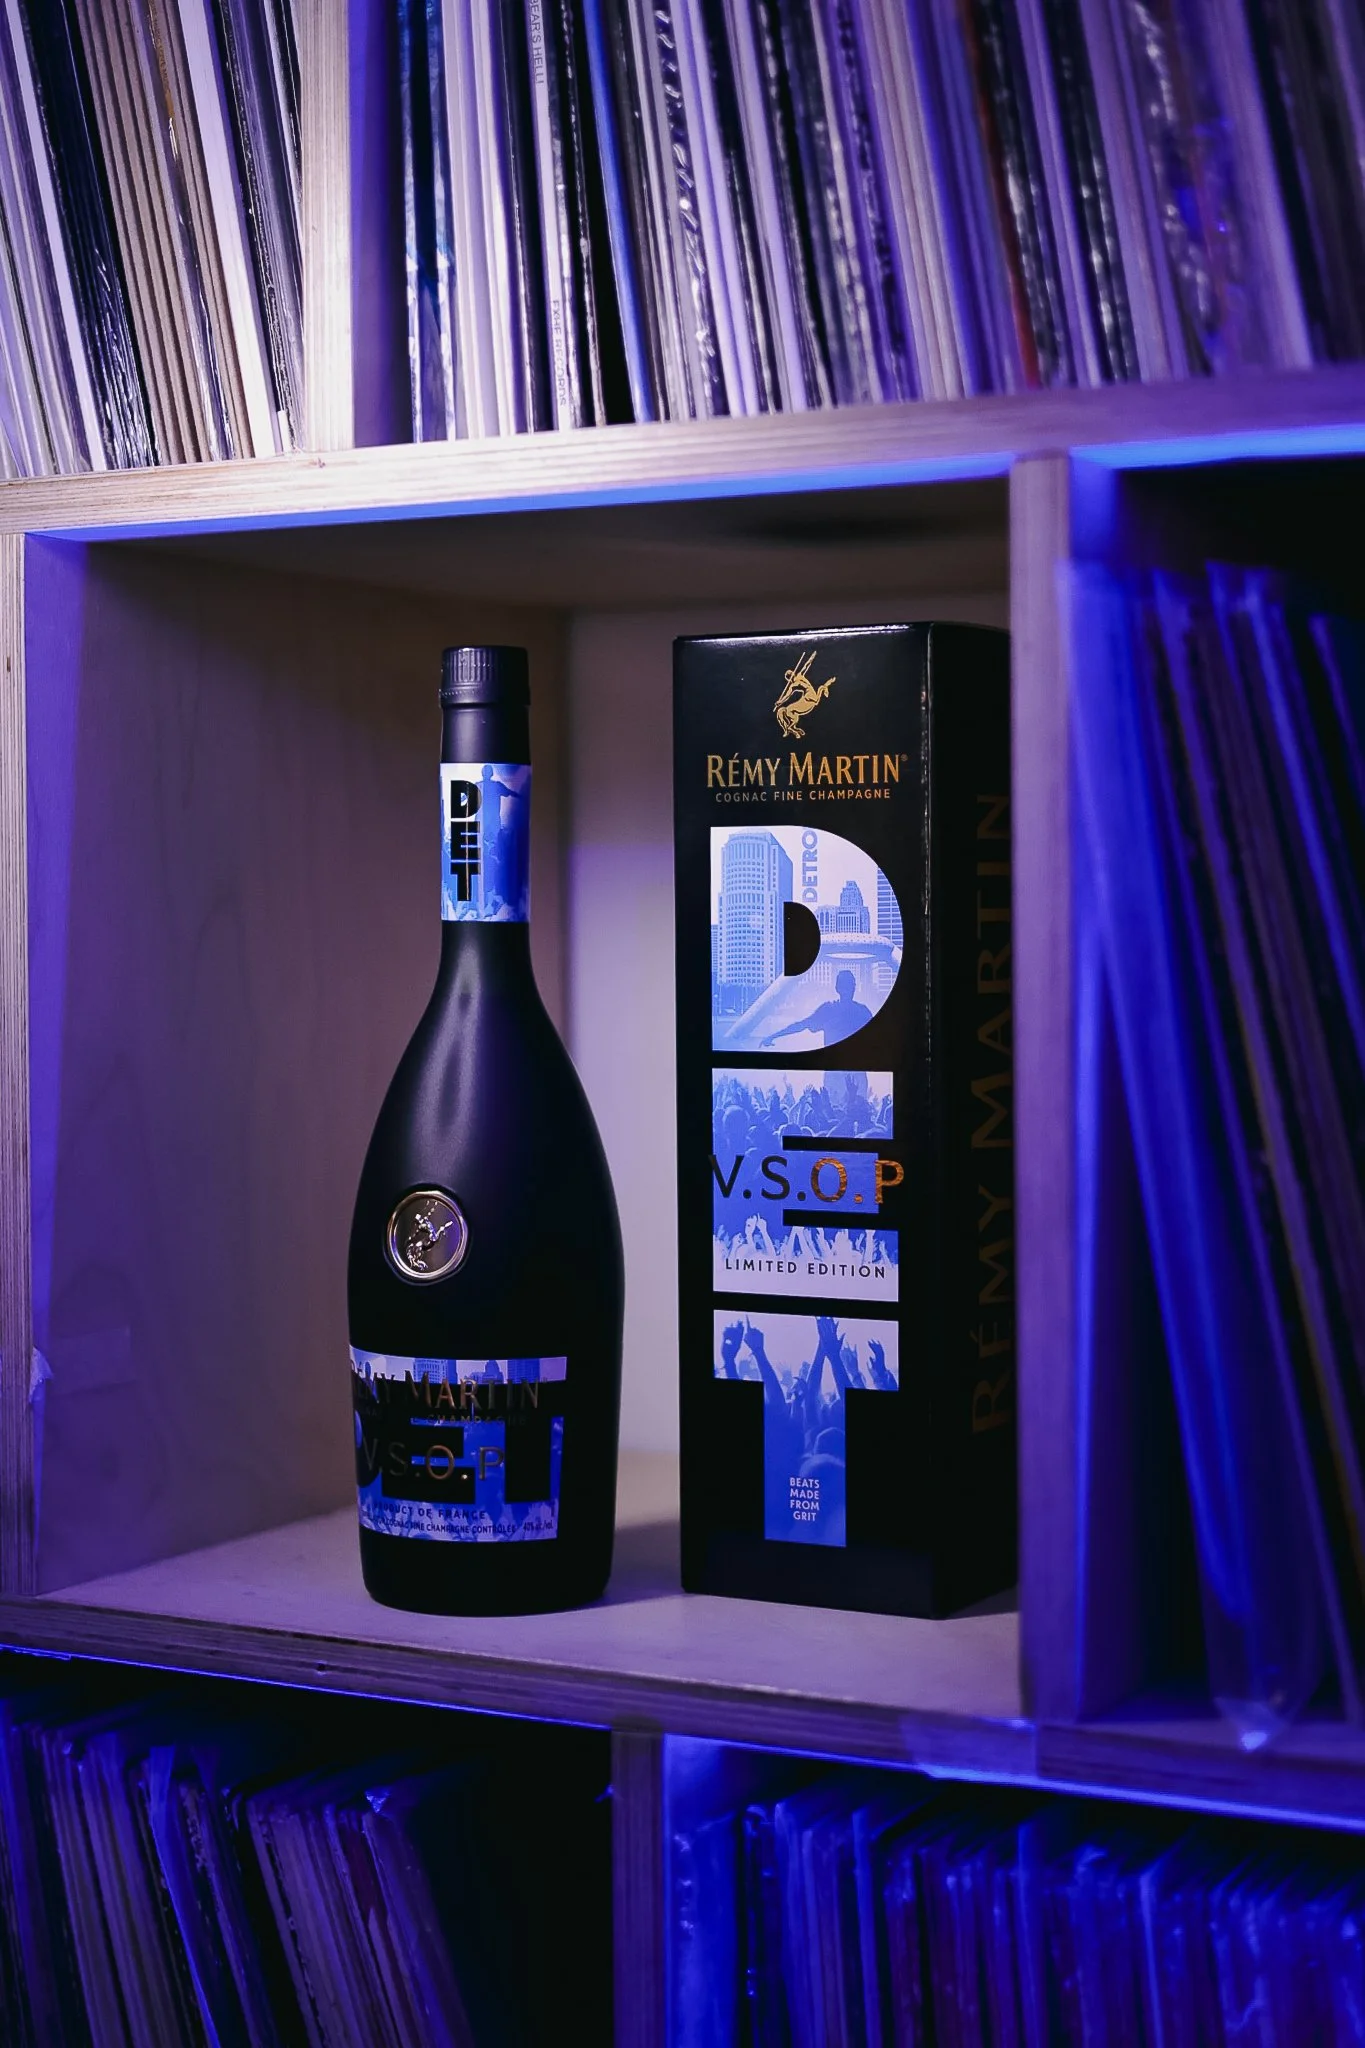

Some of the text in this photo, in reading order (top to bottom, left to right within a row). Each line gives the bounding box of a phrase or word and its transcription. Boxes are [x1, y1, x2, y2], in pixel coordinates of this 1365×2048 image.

[706, 752, 781, 788] RÉMY
[715, 788, 891, 803] COGNAC FINE CHAMPAGNE
[449, 779, 482, 902] DET
[801, 829, 819, 904] DETRO
[970, 793, 1011, 1150] MARTIN
[708, 1153, 905, 1205] V.S.O.P
[725, 1257, 887, 1280] LIMITED EDITION
[789, 1477, 820, 1489] BEATS
[789, 1488, 820, 1500] MADE
[418, 1508, 432, 1518] OF
[438, 1509, 486, 1520] FRANCE
[789, 1499, 820, 1511] FROM
[792, 1510, 817, 1522] GRIT
